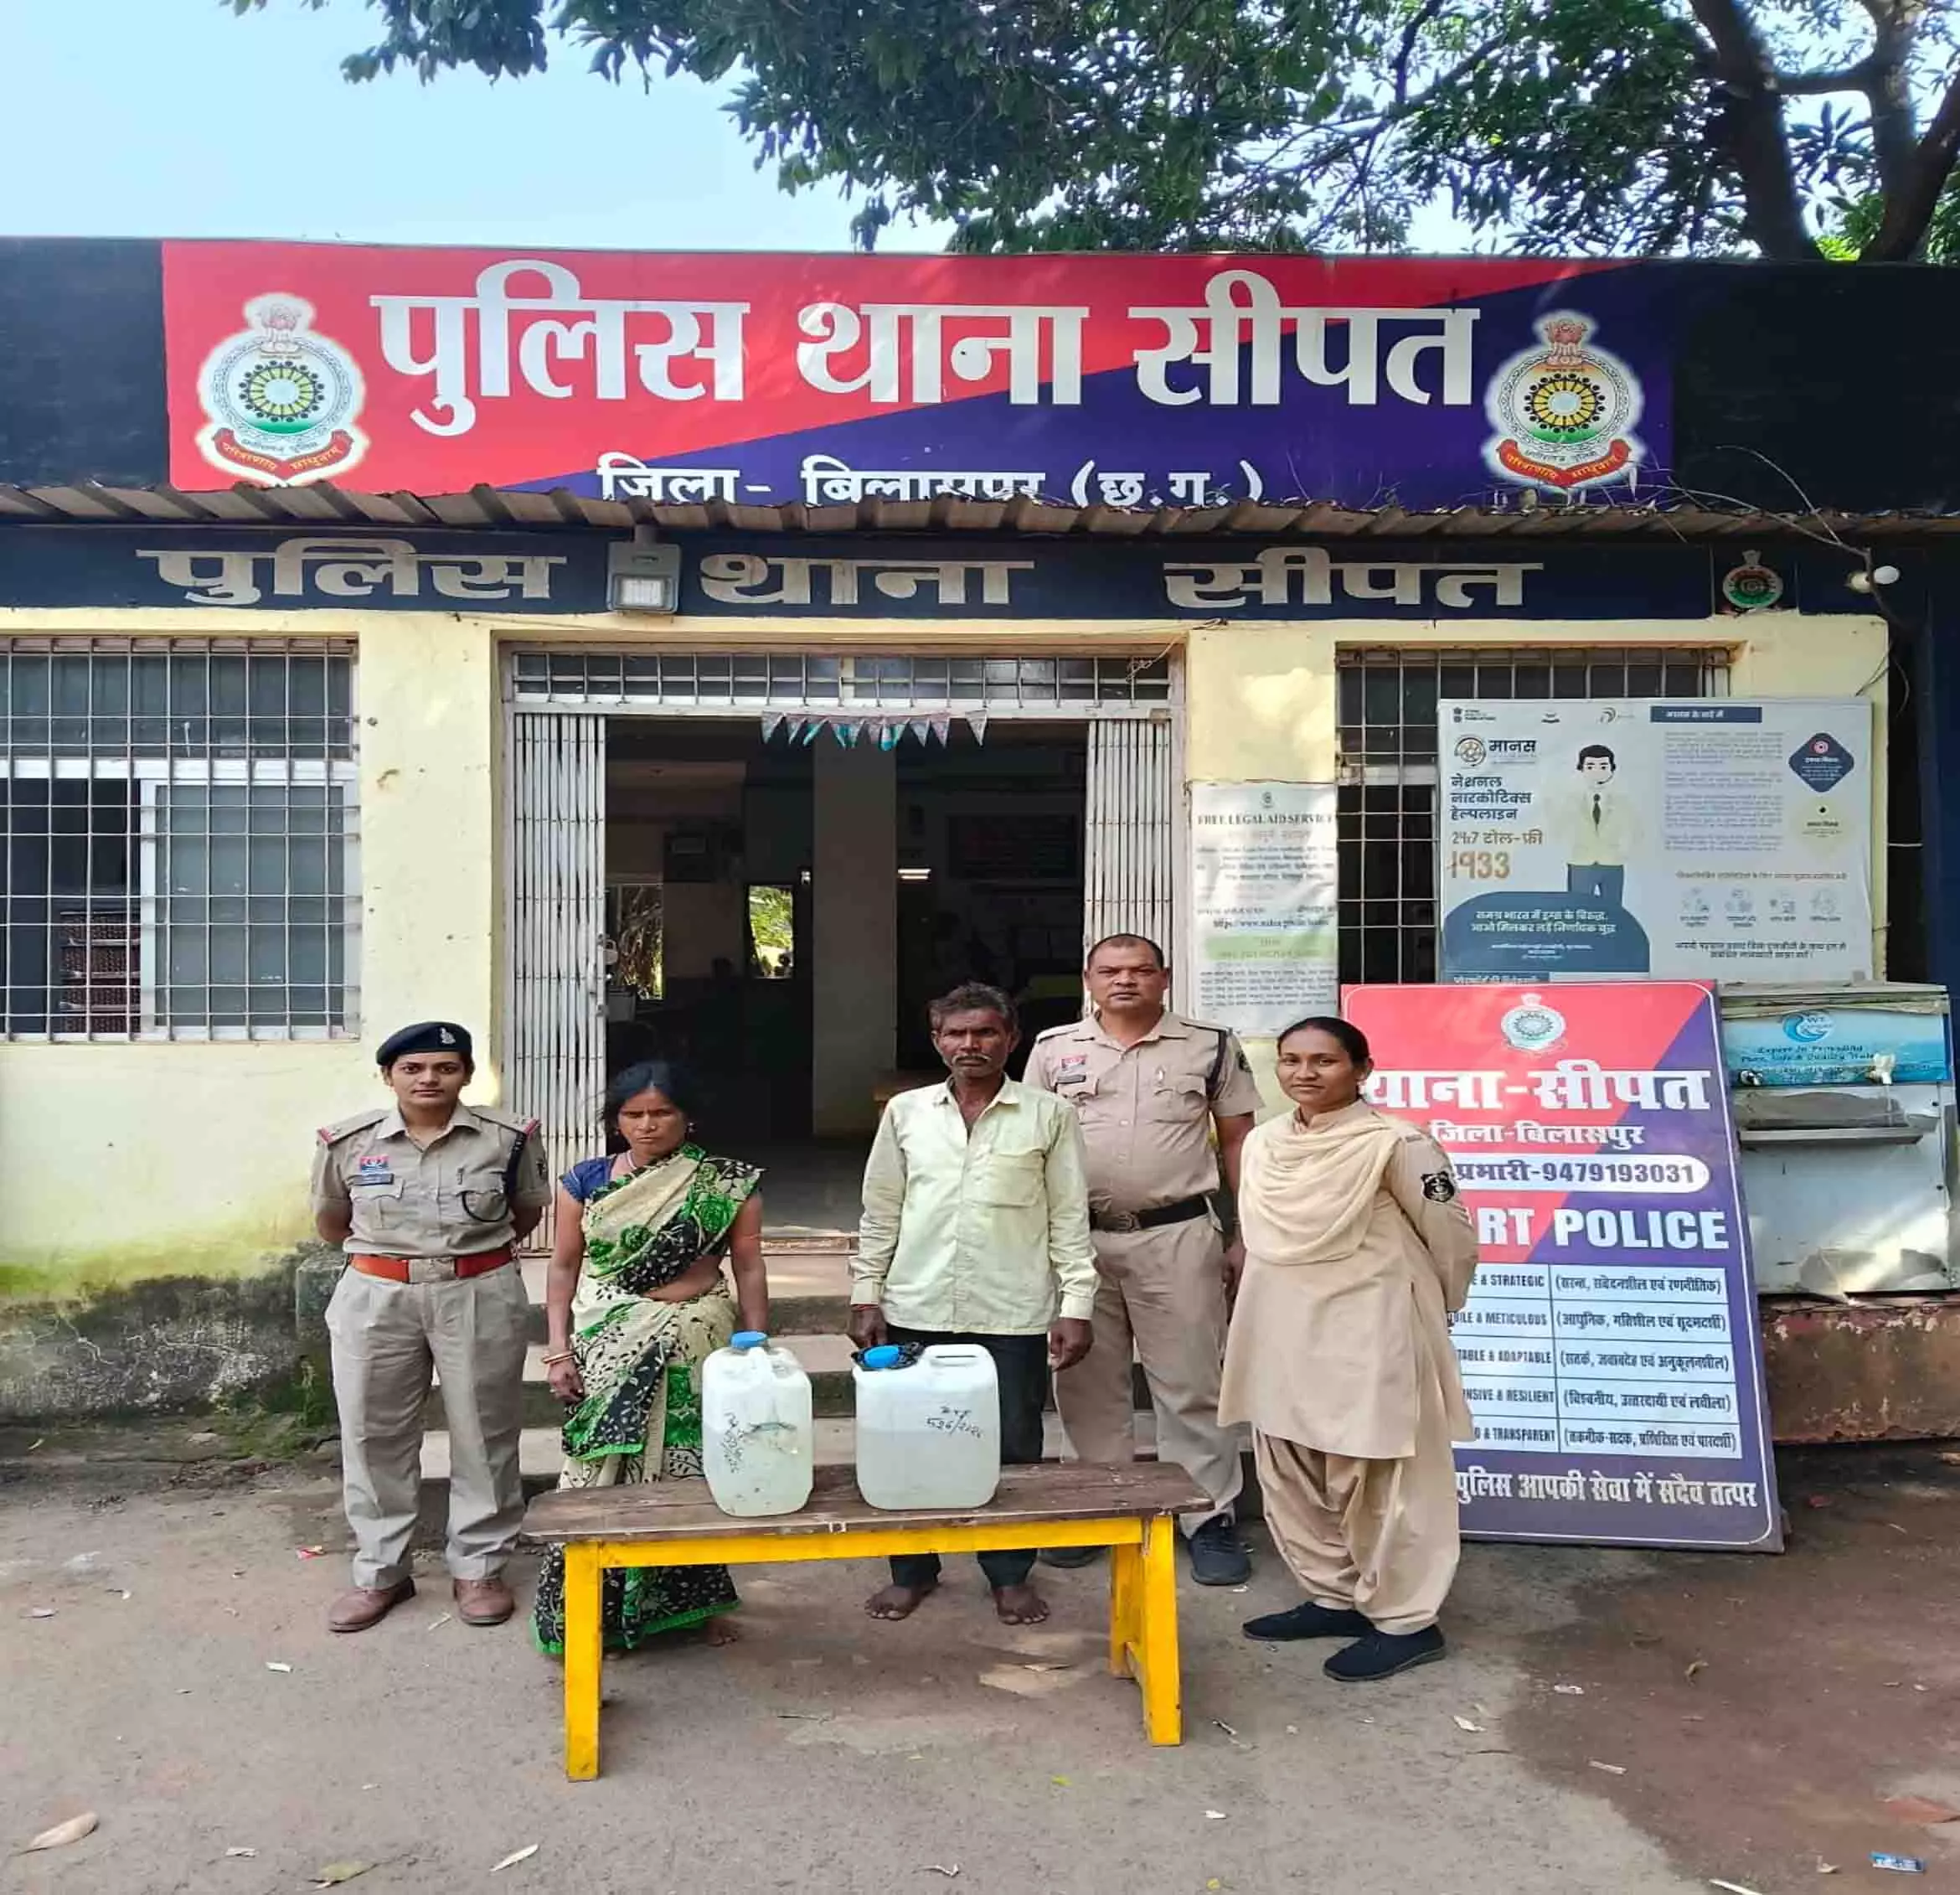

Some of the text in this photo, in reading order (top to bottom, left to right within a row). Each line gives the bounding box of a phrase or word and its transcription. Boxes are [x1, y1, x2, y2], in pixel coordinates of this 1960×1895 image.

[369, 260, 1481, 436] पुलिस थाना सीपत
[136, 538, 1544, 608] पुलिस थाना सीपत
[1488, 739, 1536, 752] मानस
[1451, 772, 1503, 787] नेशनल
[1450, 806, 1519, 820] हेल्पलाइन
[1452, 850, 1510, 879] 1933
[1360, 1060, 1711, 1111] थाना-सीपत
[1430, 1120, 1646, 1150] जिला-बिलासपुर
[1454, 1159, 1694, 1185] प्रभारी-9479193031
[1466, 1208, 1730, 1250] RT POLICE
[1491, 1274, 1545, 1287] STRATEGIC
[1507, 1390, 1555, 1403] RESILIENT
[1493, 1428, 1555, 1441] TRANSPARENT
[1455, 1466, 1512, 1505] पुलिस
[1518, 1469, 1586, 1502] आपकी
[1590, 1471, 1630, 1502] सेवा
[1633, 1471, 1654, 1504] में
[1707, 1481, 1758, 1508] तत्पर
